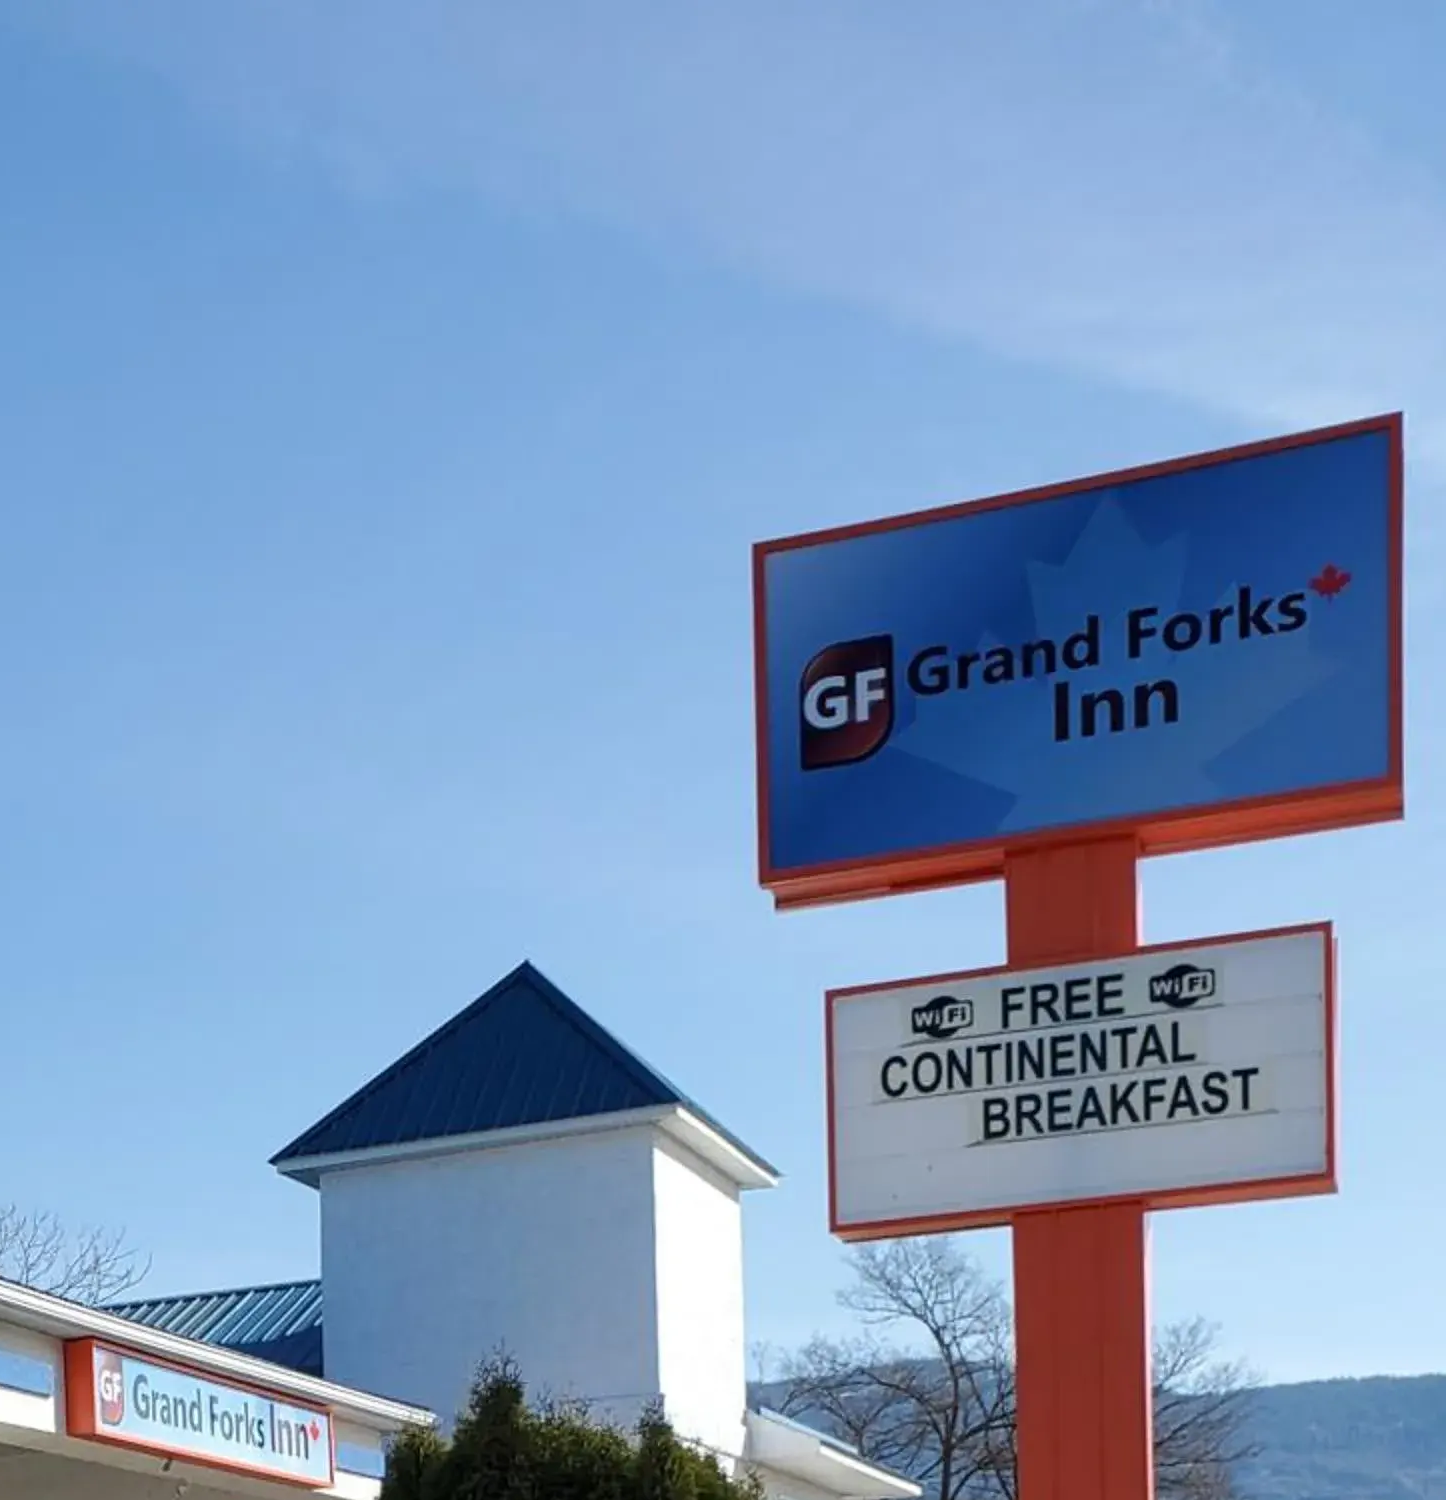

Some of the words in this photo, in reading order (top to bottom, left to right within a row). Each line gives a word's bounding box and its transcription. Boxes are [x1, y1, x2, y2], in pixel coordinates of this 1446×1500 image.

[906, 614, 1100, 696] Grand
[1127, 585, 1308, 659] Forks
[804, 667, 886, 729] GF
[1054, 676, 1180, 742] Inn
[1001, 973, 1125, 1029] FREE
[880, 1021, 1197, 1098] CONTINENTAL
[982, 1067, 1260, 1140] BREAKFAST
[101, 1369, 121, 1402] GF
[132, 1374, 203, 1433] Grand
[209, 1395, 266, 1449] Forks
[269, 1403, 310, 1461] Inn
